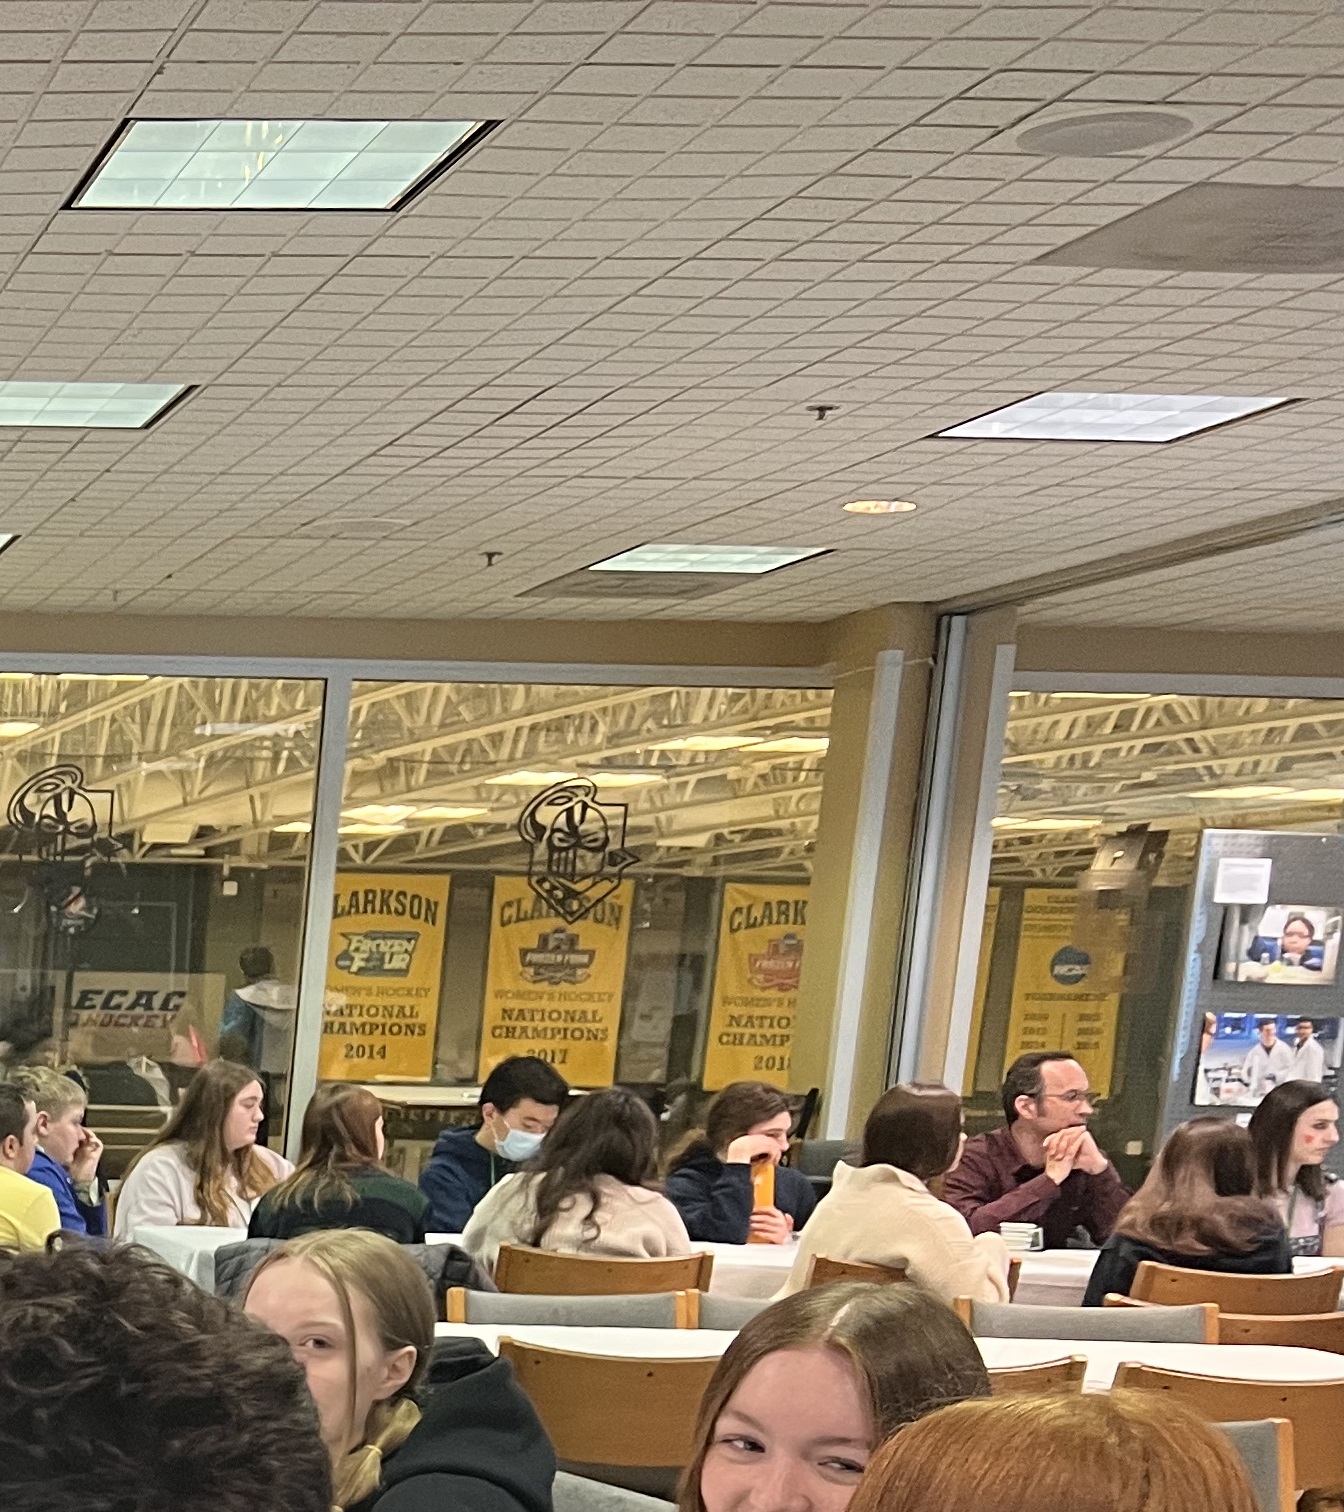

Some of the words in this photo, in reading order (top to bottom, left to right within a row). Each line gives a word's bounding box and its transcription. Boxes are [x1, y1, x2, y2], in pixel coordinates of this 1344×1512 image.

[332, 888, 439, 926] LARKSON
[729, 900, 808, 935] CLARK
[74, 989, 187, 1012] ECAC
[501, 1008, 603, 1024] NATIONAL
[725, 1014, 792, 1030] NATIO
[323, 1022, 427, 1037] HAMPIONS
[491, 1025, 609, 1041] CHAMPIONS
[718, 1031, 791, 1047] CHAMP
[344, 1043, 387, 1060] 2014
[753, 1055, 792, 1071] 201
